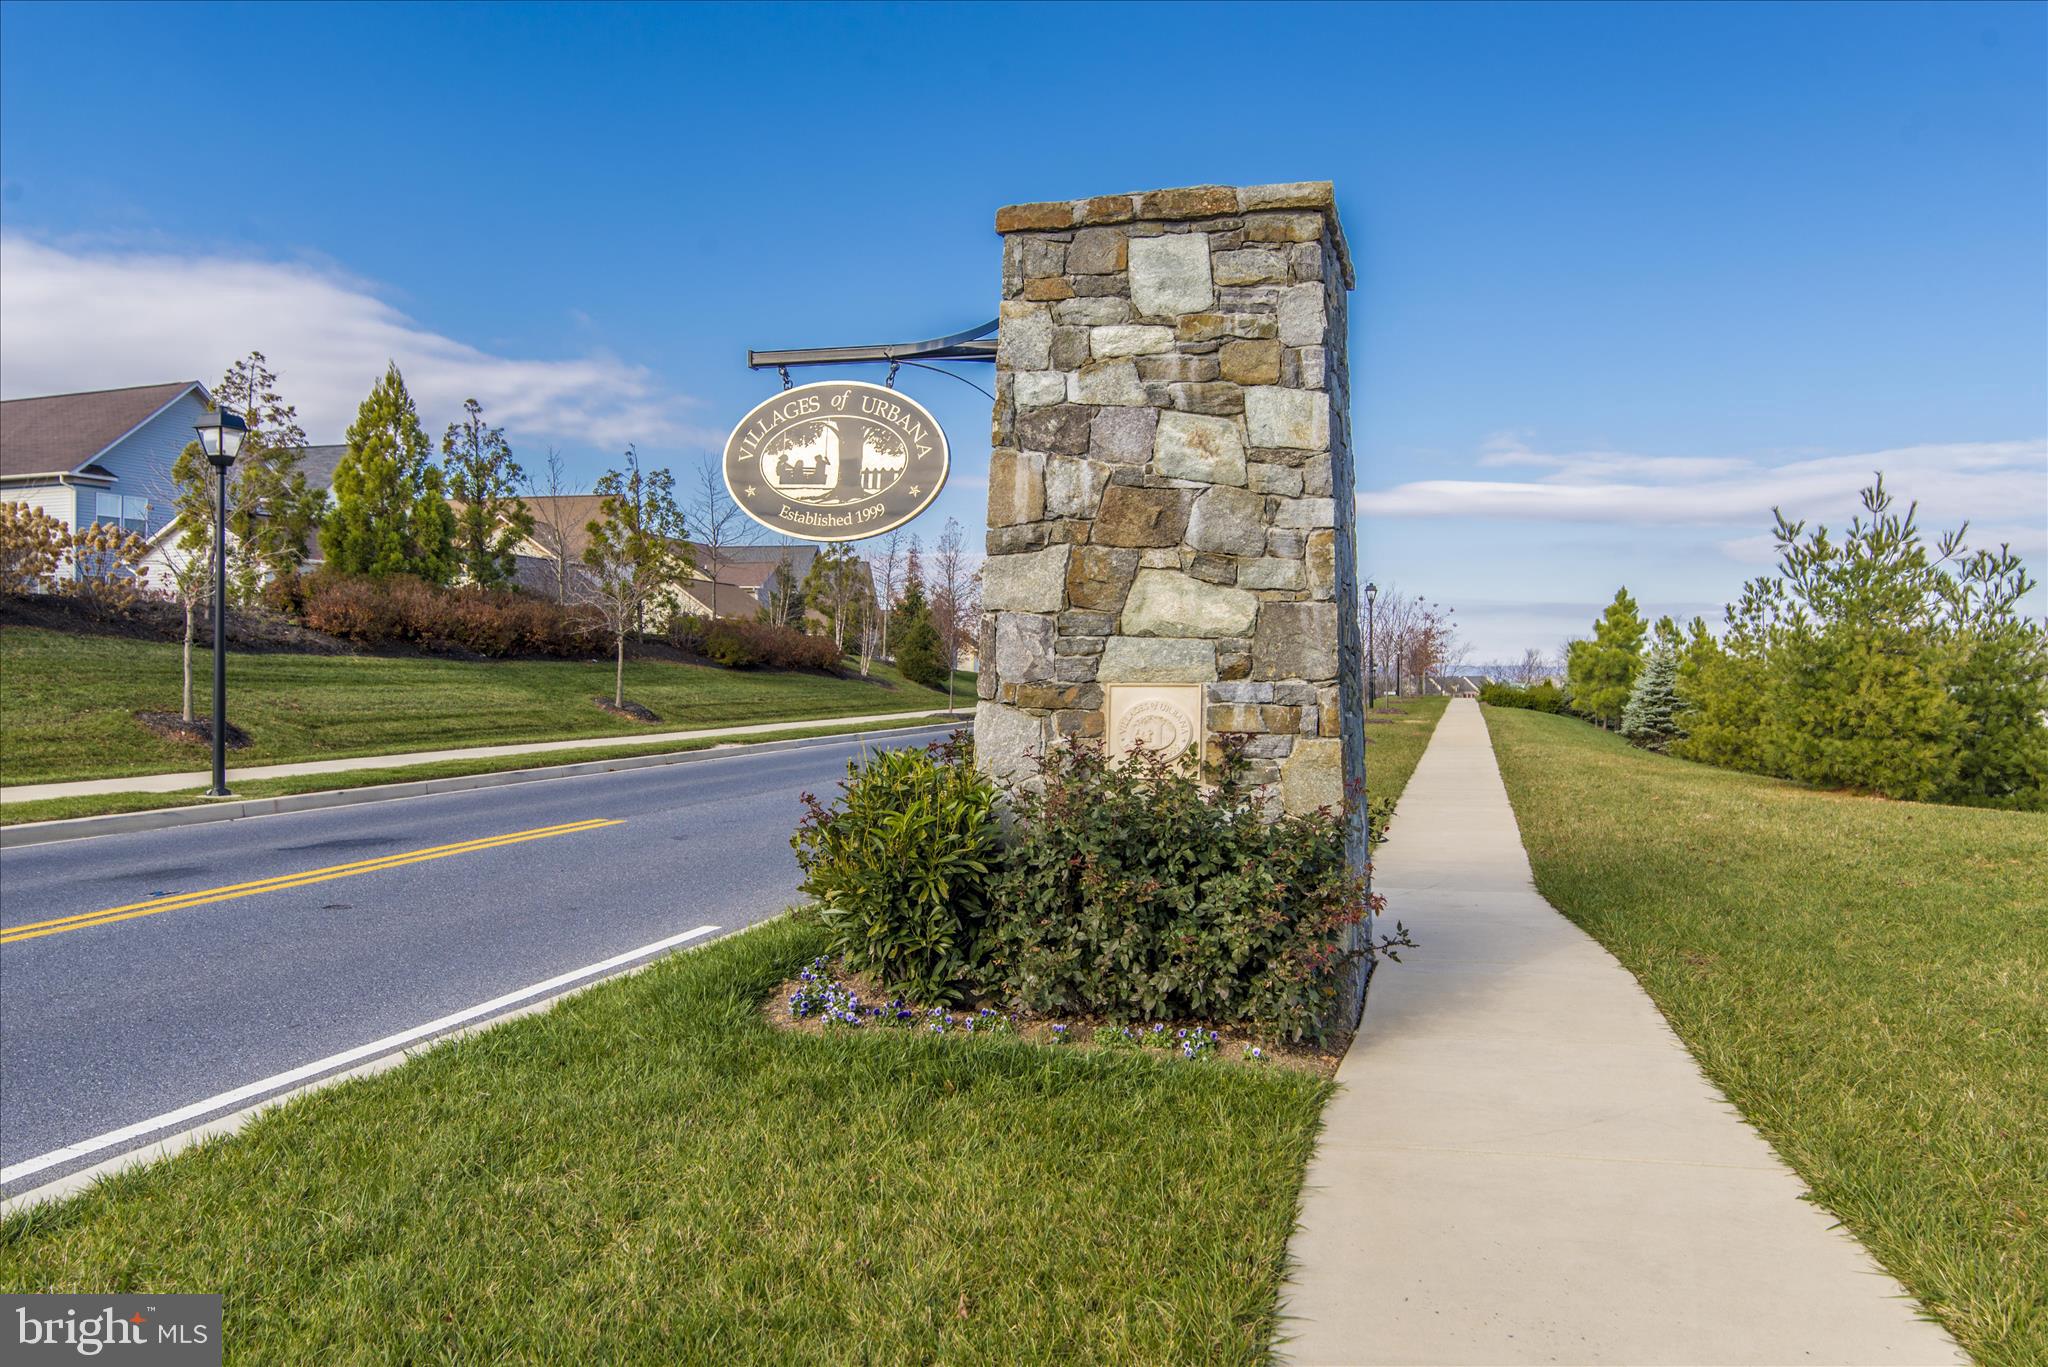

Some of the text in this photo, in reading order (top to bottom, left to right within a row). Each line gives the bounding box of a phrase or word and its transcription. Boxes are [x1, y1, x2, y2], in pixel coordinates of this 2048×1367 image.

[738, 389, 933, 462] VILLAGES of URBANA
[779, 503, 885, 527] Established 1999
